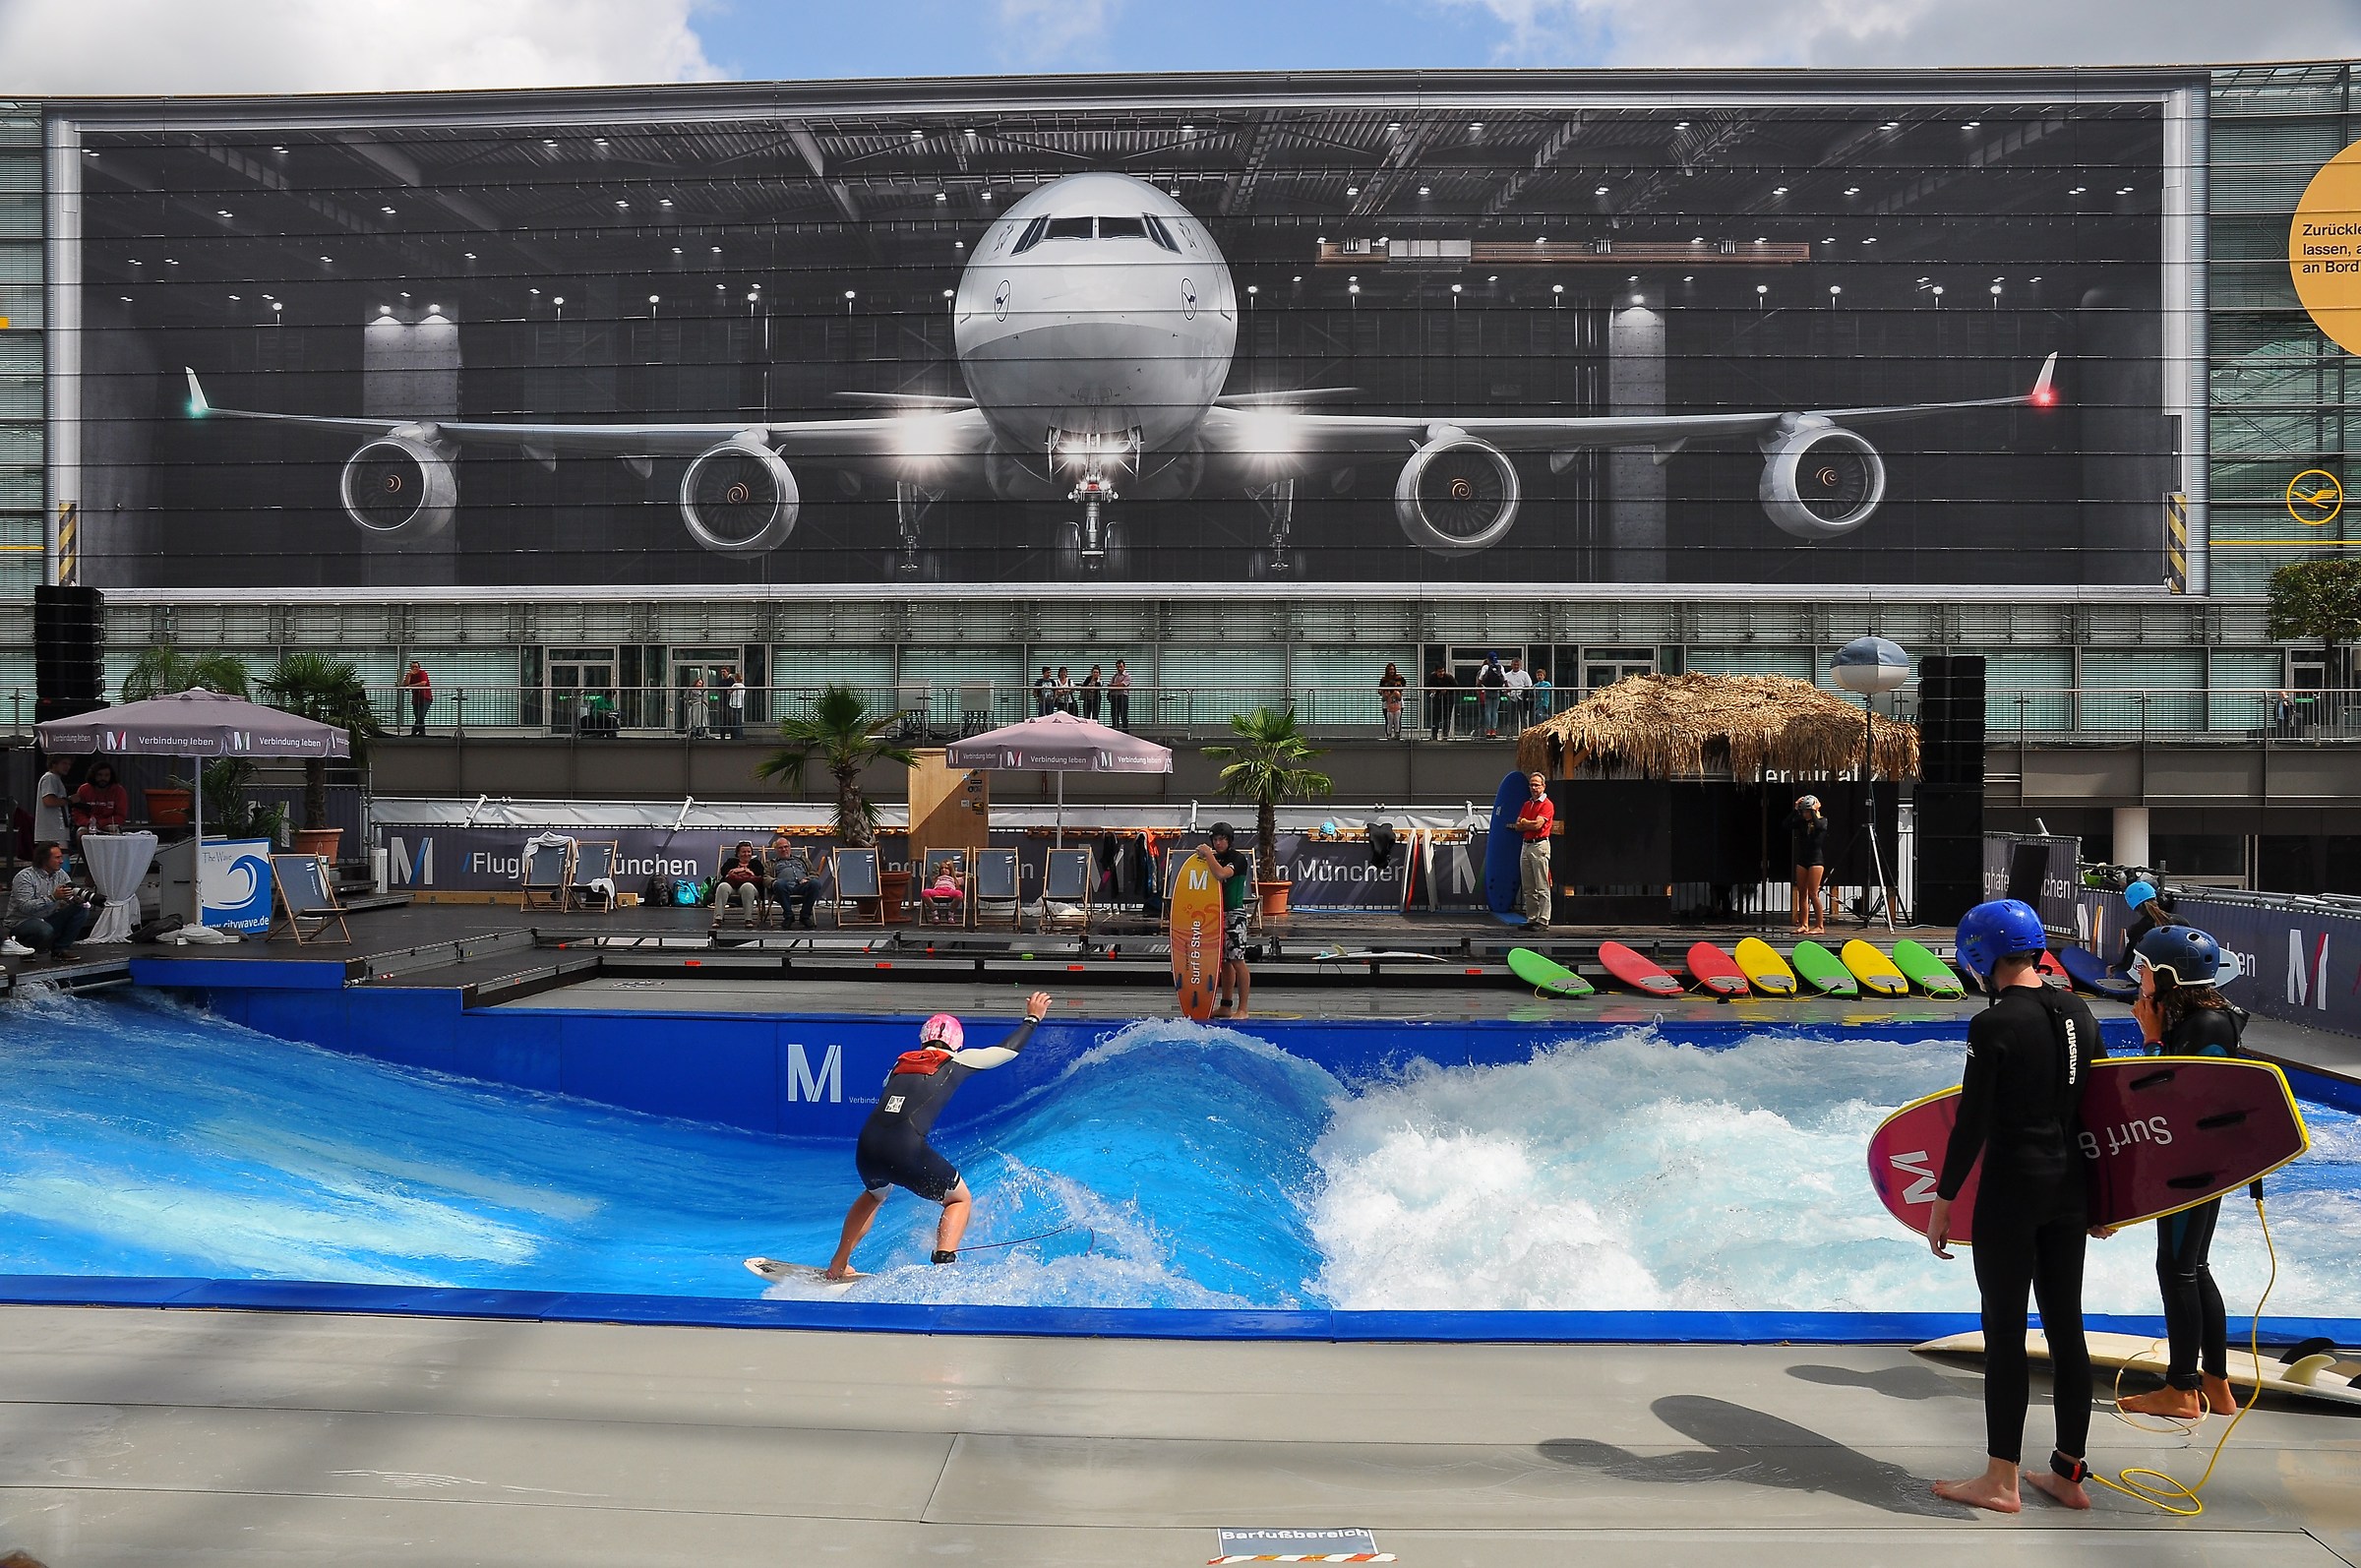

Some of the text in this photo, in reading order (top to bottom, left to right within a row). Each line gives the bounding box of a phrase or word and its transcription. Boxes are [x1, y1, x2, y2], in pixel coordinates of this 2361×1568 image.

[2303, 243, 2351, 257] lassen,
[2303, 261, 2359, 272] an Bord
[106, 731, 127, 751] M
[139, 737, 187, 747] Verbindung
[233, 731, 322, 751] M Verbindung leben
[1006, 751, 1022, 766] M
[1030, 755, 1067, 764] Verbindung
[1117, 755, 1147, 765] Verbindung
[391, 837, 434, 885] M
[612, 853, 697, 875] ünchen
[1188, 870, 1209, 890] M
[1190, 921, 1201, 985] Surf & Style
[2287, 929, 2330, 1011] M
[788, 1044, 841, 1103] M
[2106, 1116, 2173, 1157] Surf
[1222, 1528, 1368, 1539] Barfußbereich
